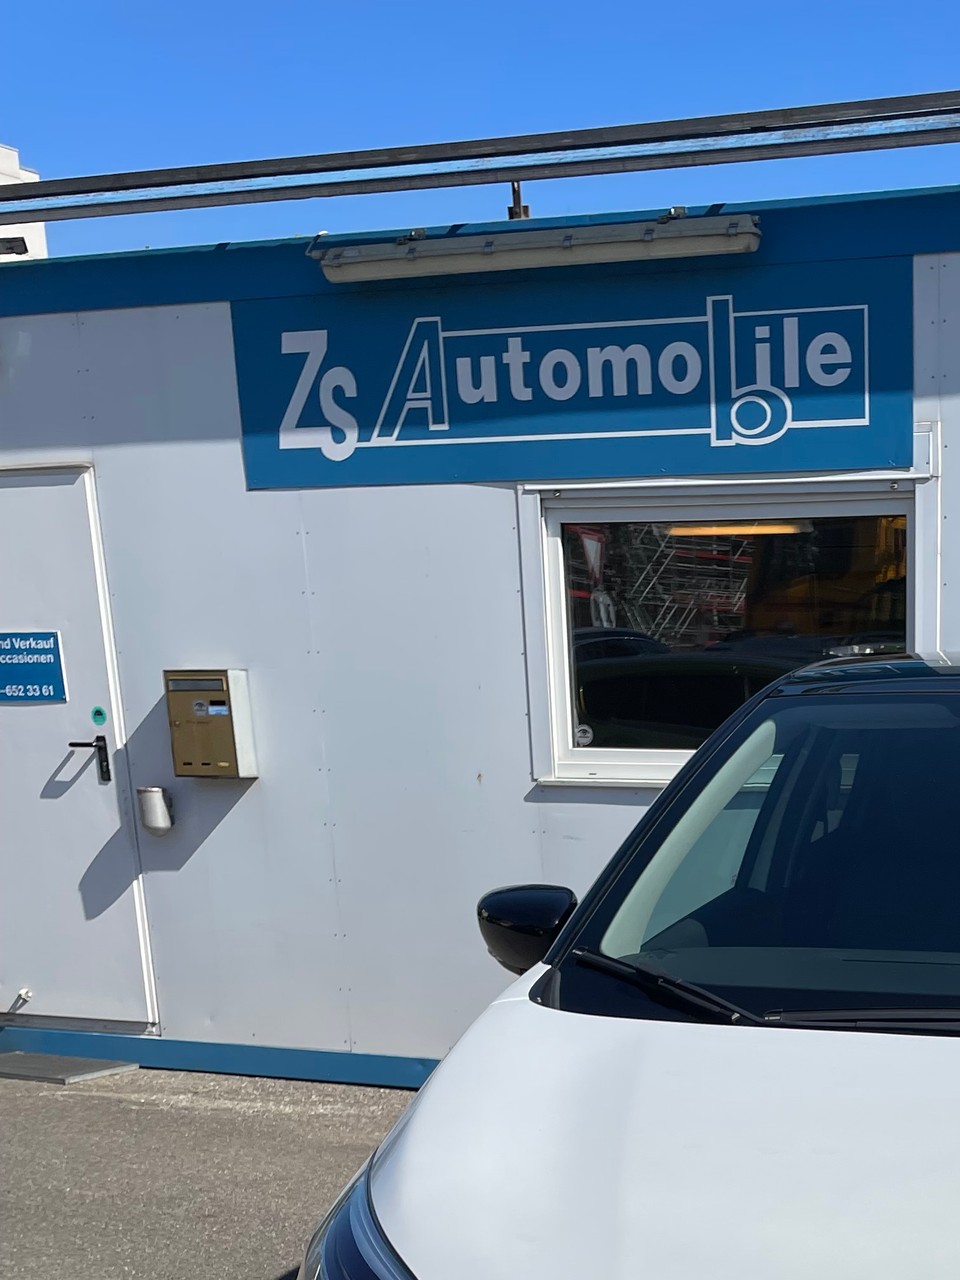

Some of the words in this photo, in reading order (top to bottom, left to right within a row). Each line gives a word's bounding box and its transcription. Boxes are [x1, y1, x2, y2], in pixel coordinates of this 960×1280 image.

[370, 295, 853, 447] Automobile
[12, 637, 54, 649] Verkauf
[26, 685, 40, 697] 33
[42, 685, 54, 696] 61
